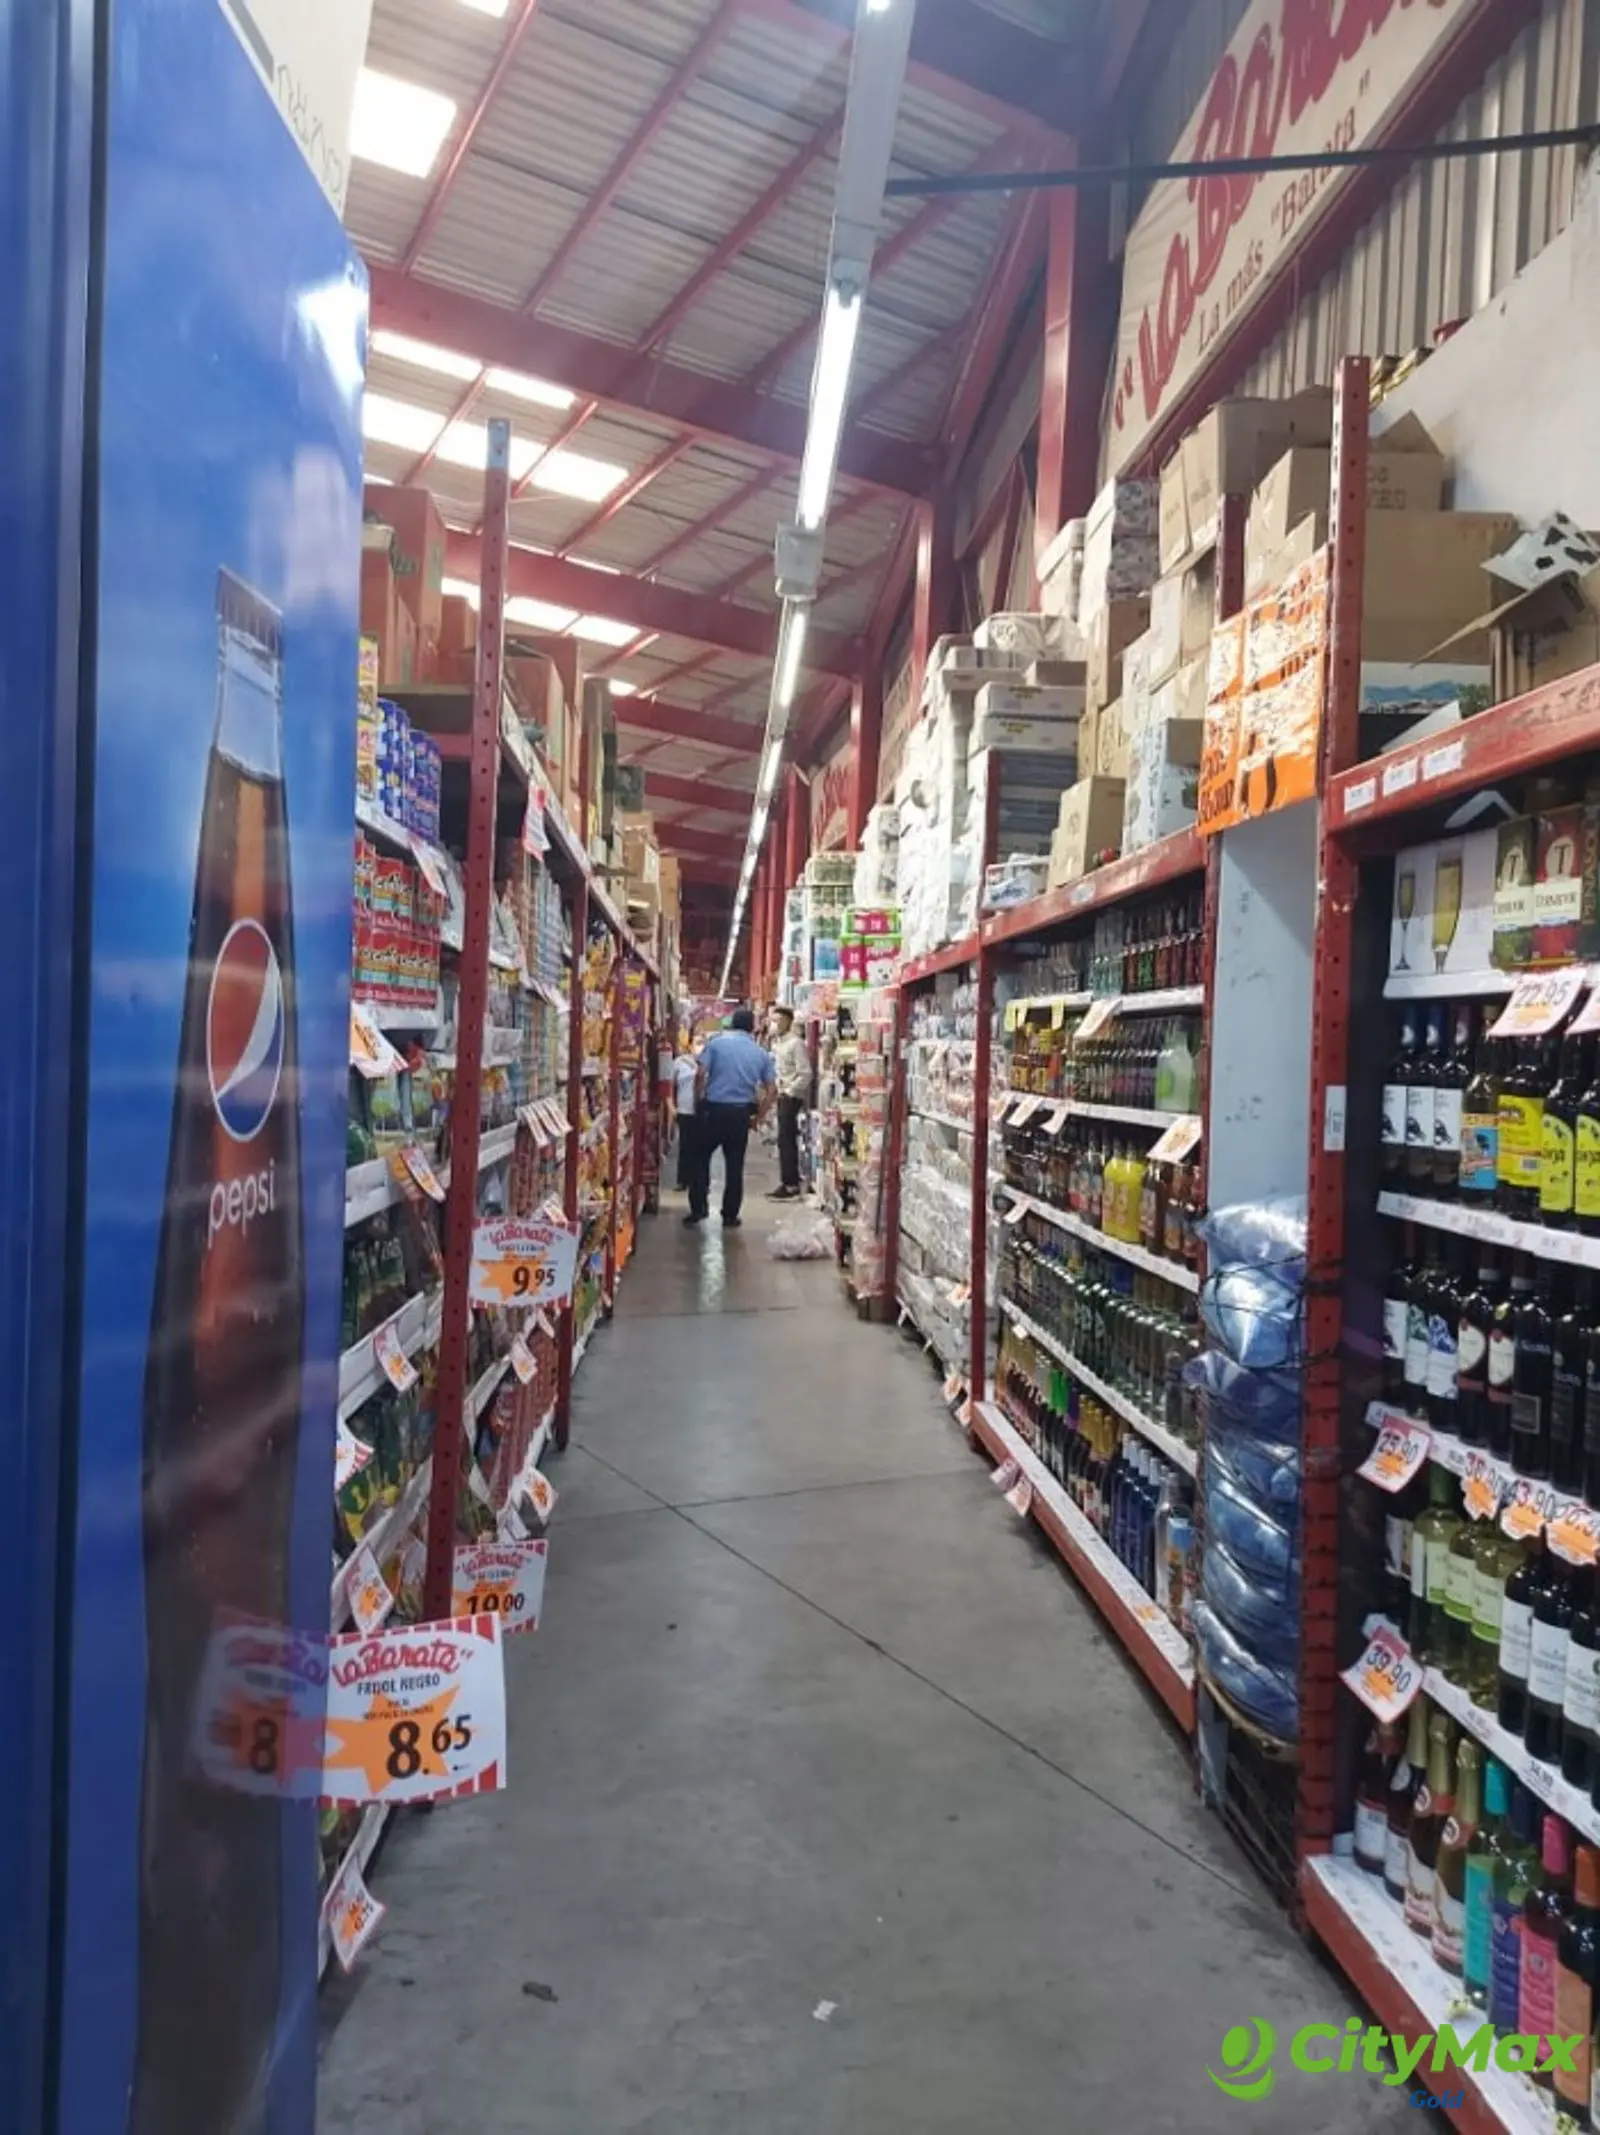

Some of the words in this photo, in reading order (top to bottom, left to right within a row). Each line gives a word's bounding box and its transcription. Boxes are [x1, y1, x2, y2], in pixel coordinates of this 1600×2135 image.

[1226, 238, 1264, 318] más
[207, 1158, 277, 1250] pepsi
[400, 1672, 441, 1692] NEGRO
